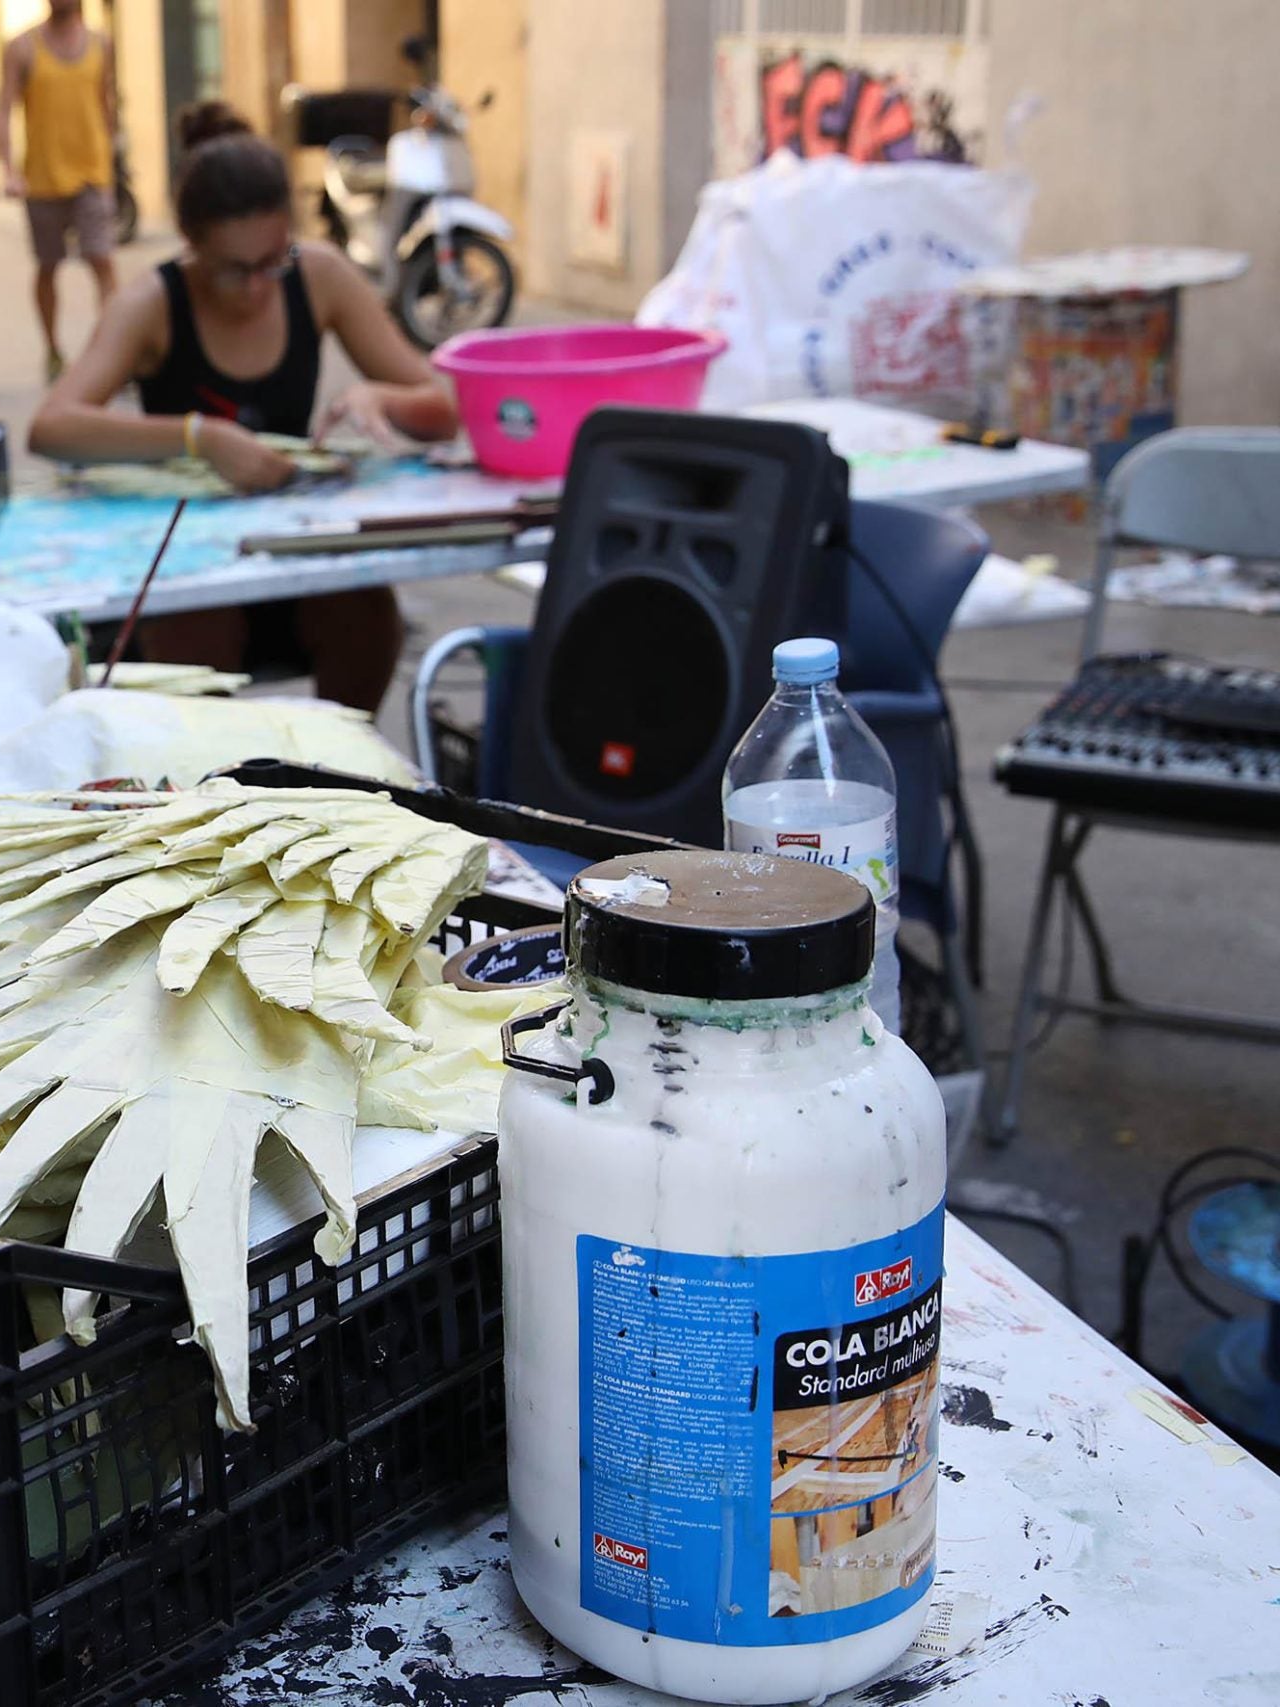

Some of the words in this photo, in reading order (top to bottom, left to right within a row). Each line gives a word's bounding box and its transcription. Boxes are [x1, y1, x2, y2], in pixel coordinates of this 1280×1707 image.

[778, 835, 818, 844] Gourmet
[882, 1265, 911, 1290] Rayt
[786, 1333, 867, 1368] COLA
[874, 1291, 939, 1352] BLANCA
[799, 1355, 888, 1396] Standard
[891, 1333, 936, 1374] multiuso
[615, 1544, 645, 1565] Rayt
